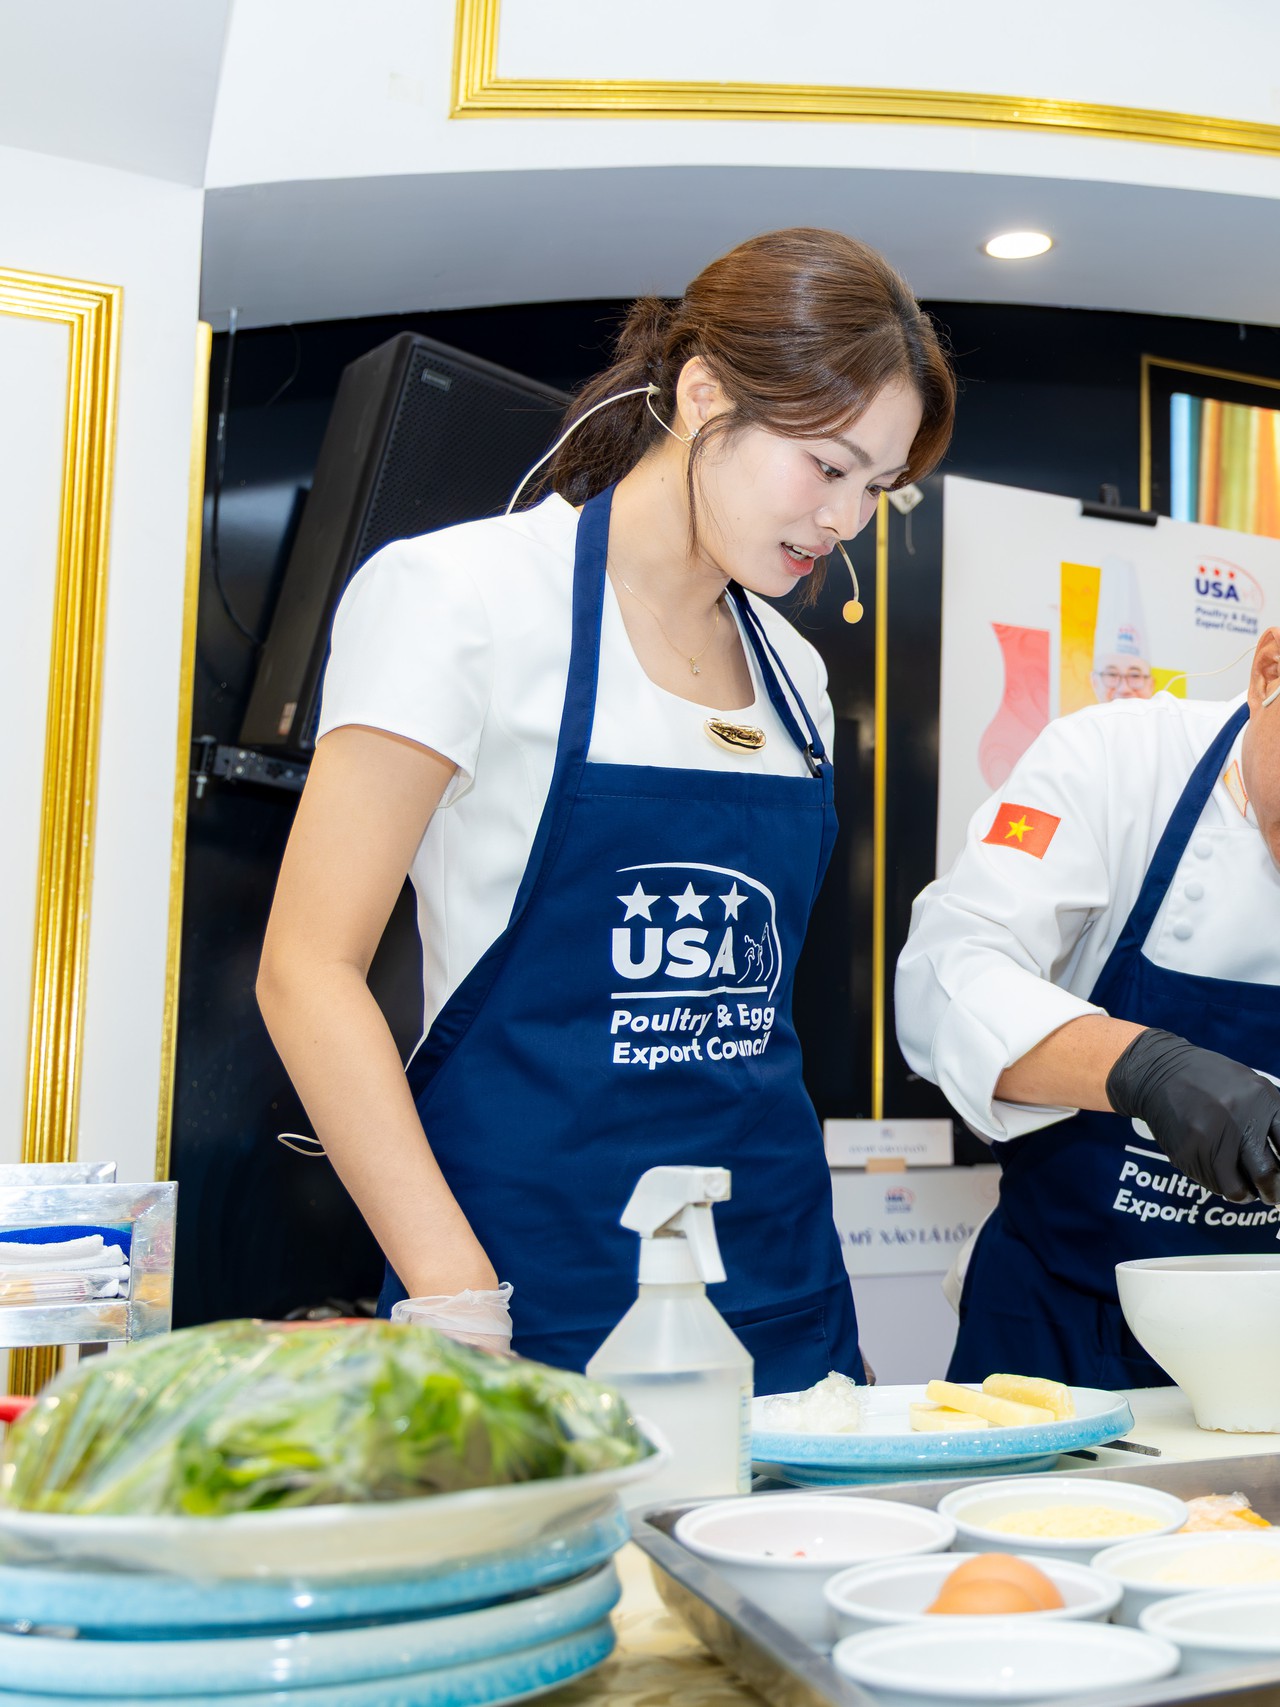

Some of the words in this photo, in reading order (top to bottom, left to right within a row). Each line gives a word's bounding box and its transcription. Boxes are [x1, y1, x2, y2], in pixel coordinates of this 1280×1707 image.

[1195, 578, 1240, 602] USA
[611, 926, 736, 980] USA
[610, 1007, 713, 1036] Poultry
[717, 1004, 734, 1029] &
[737, 1004, 775, 1031] Egg
[612, 1038, 703, 1070] Export
[706, 1031, 771, 1061] Council
[1118, 1161, 1214, 1205] Poultry
[1112, 1189, 1200, 1223] Export
[1204, 1206, 1280, 1227] Counc
